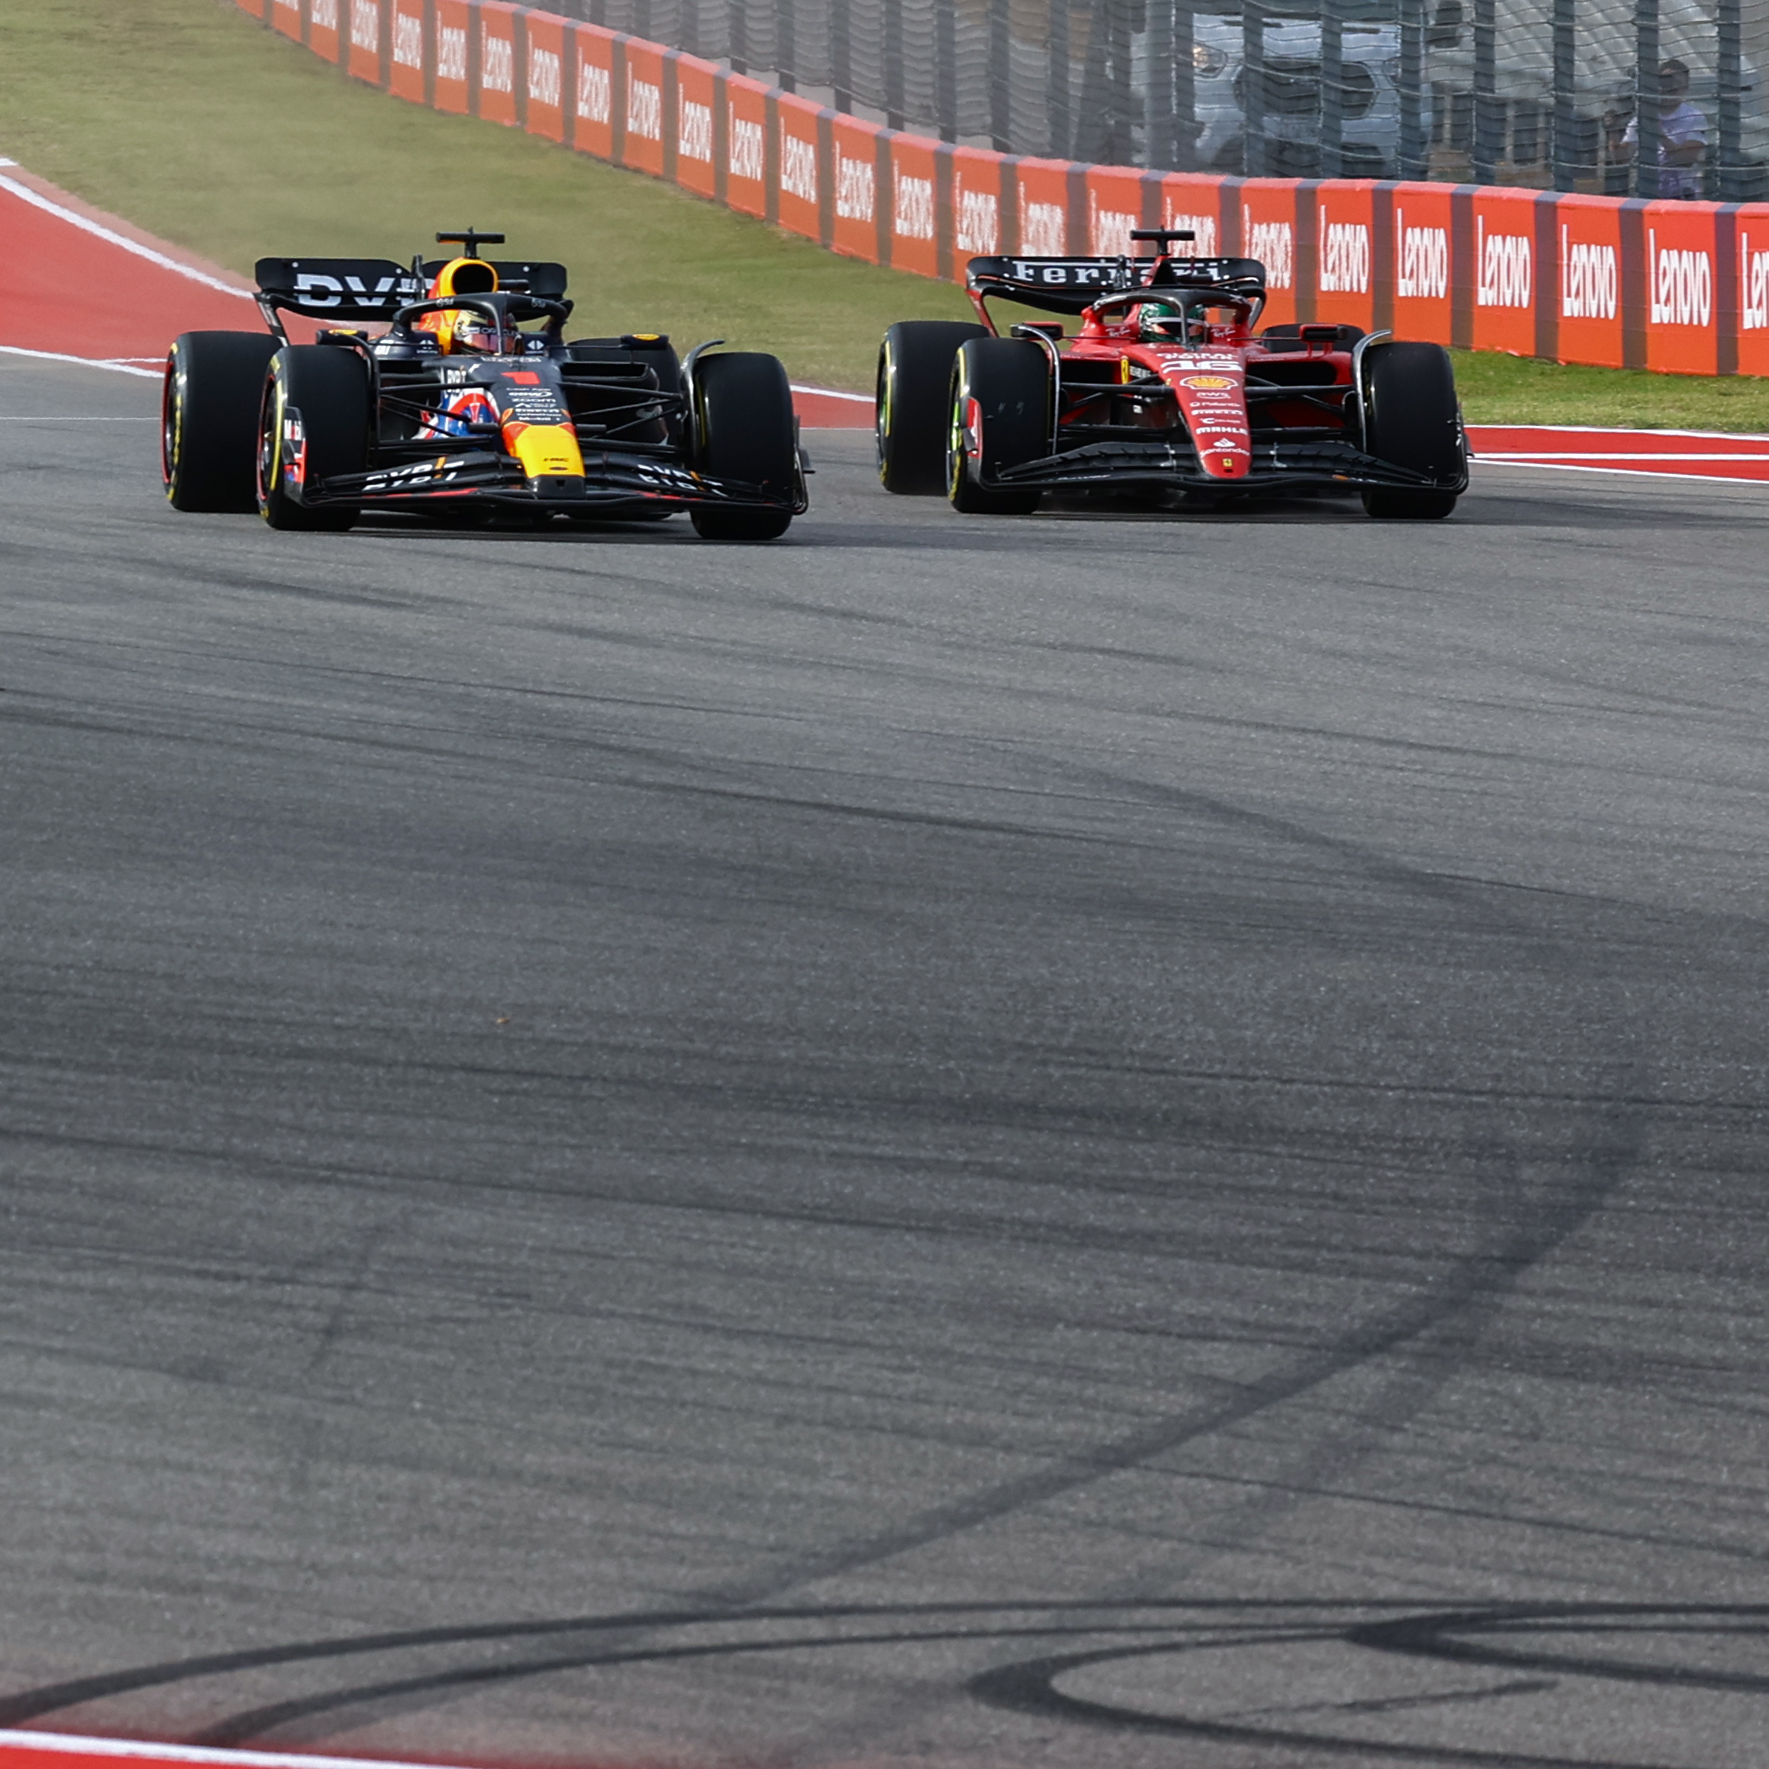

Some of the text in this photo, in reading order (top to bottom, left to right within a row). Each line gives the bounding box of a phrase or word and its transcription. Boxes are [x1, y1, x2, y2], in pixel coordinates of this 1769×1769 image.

[1013, 259, 1222, 283] Ferri
[1320, 205, 1369, 294] Lenovo
[1398, 208, 1448, 299] Lenovo
[1478, 215, 1530, 309] Lenovo
[1563, 224, 1617, 320] Lenovo
[1649, 228, 1711, 327] Lenovo
[1160, 360, 1243, 374] 16
